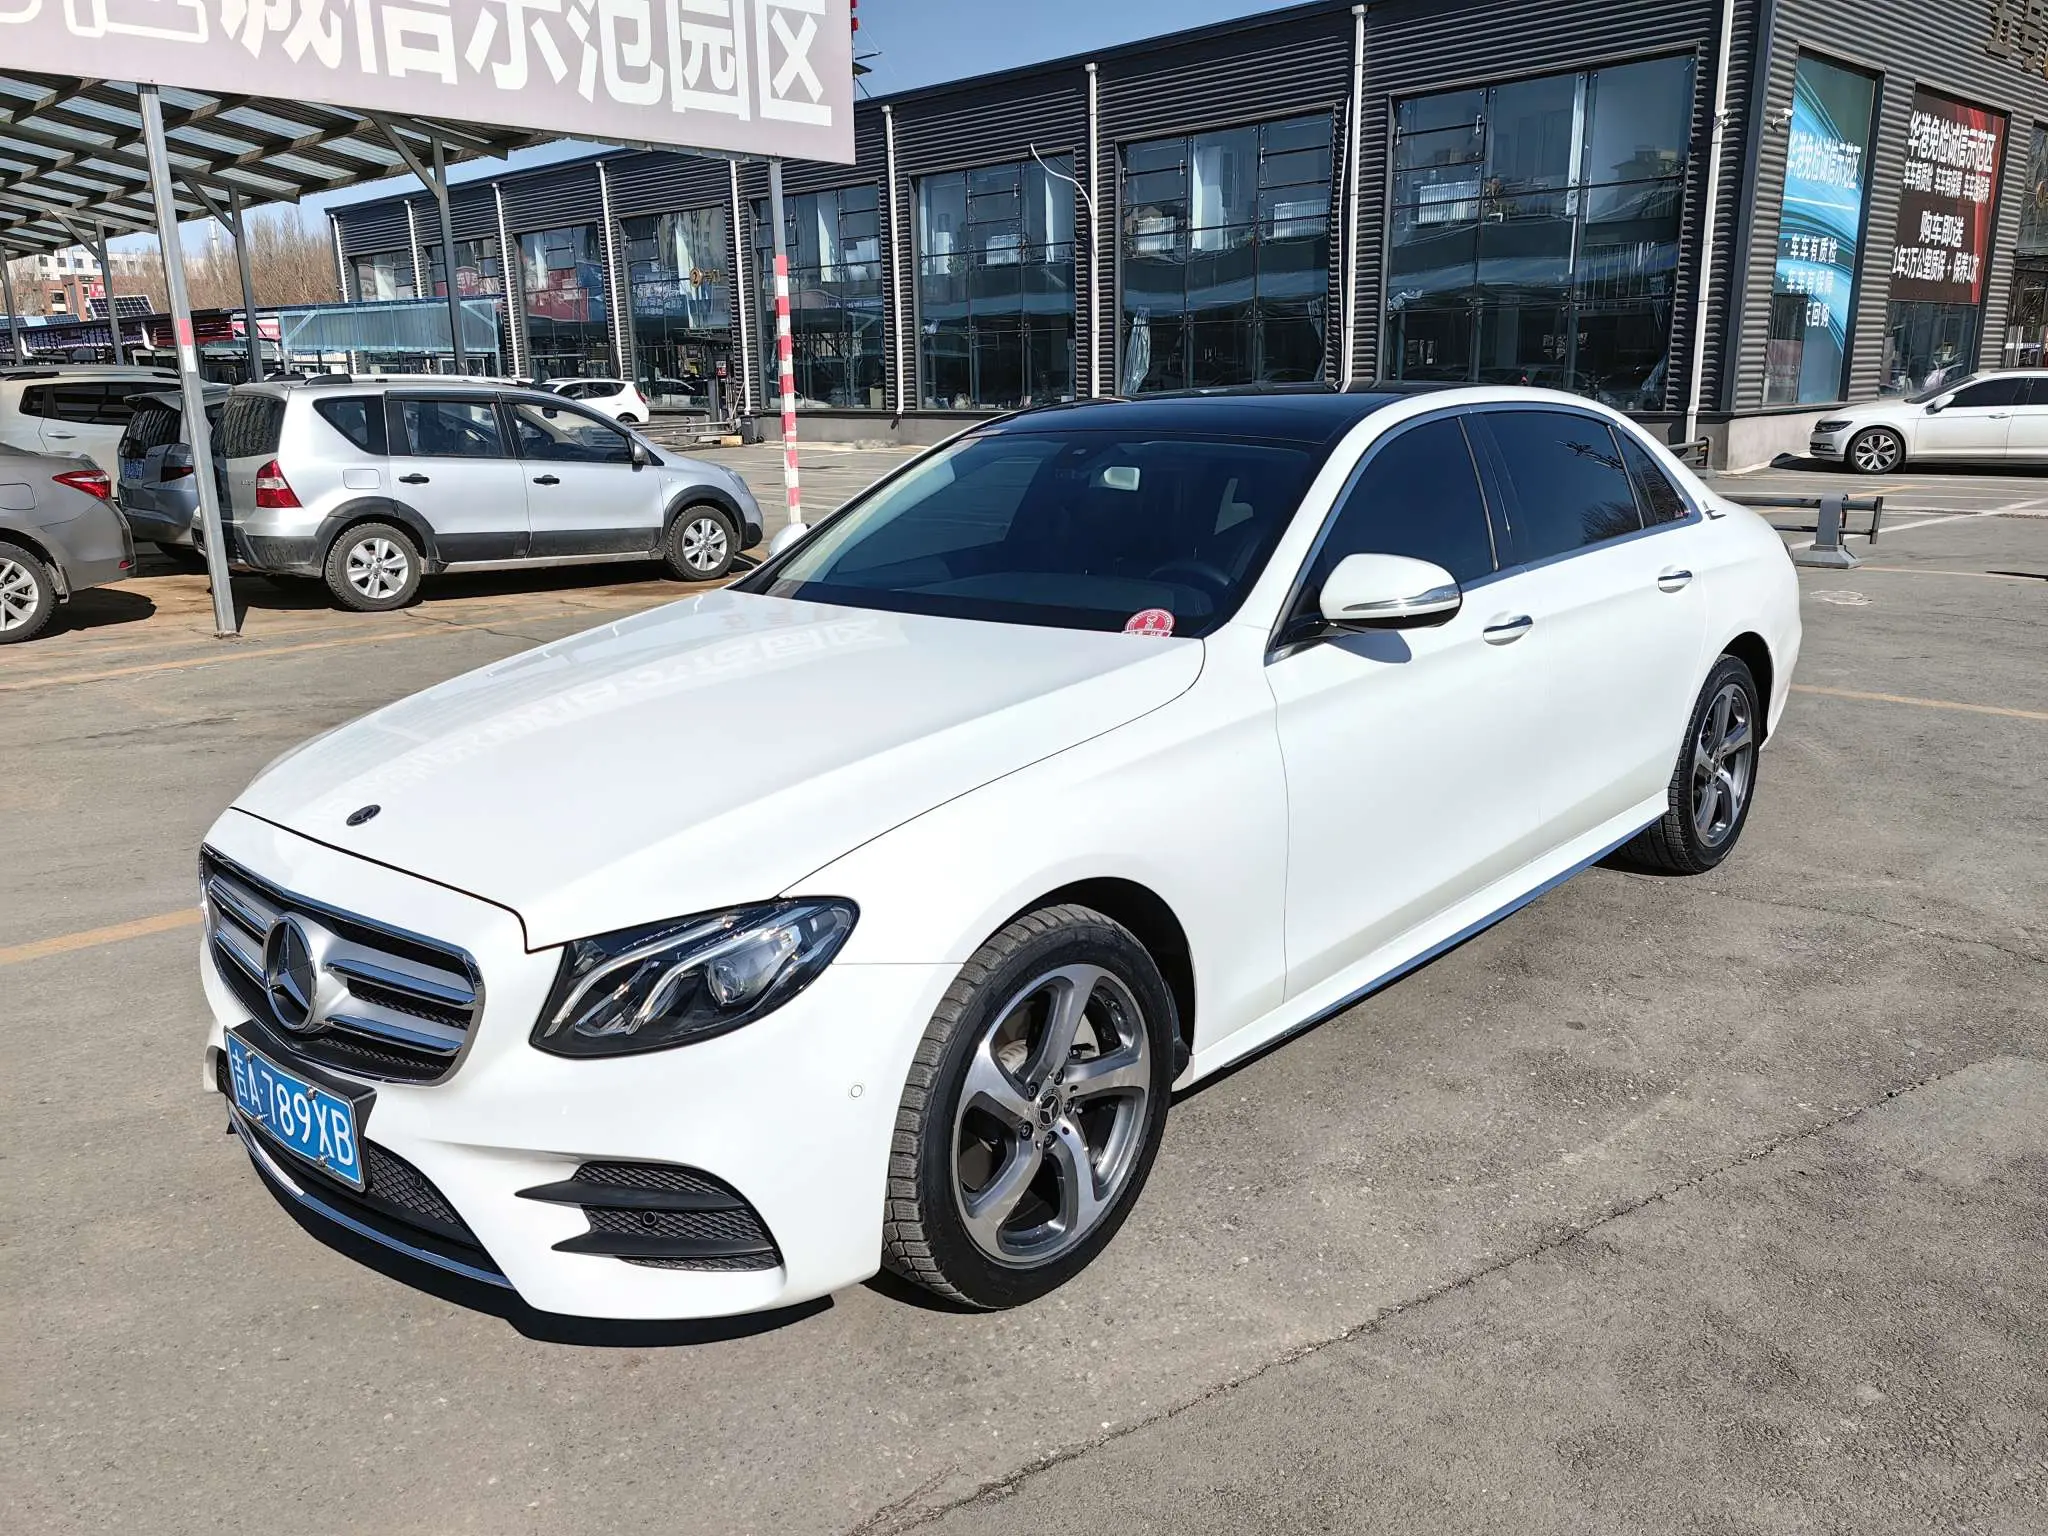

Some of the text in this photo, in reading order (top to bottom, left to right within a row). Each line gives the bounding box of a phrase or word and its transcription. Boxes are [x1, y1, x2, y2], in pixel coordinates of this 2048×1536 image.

[1908, 110, 1996, 172] 华港免检诚信示范区
[1919, 210, 1964, 247] 购车即送
